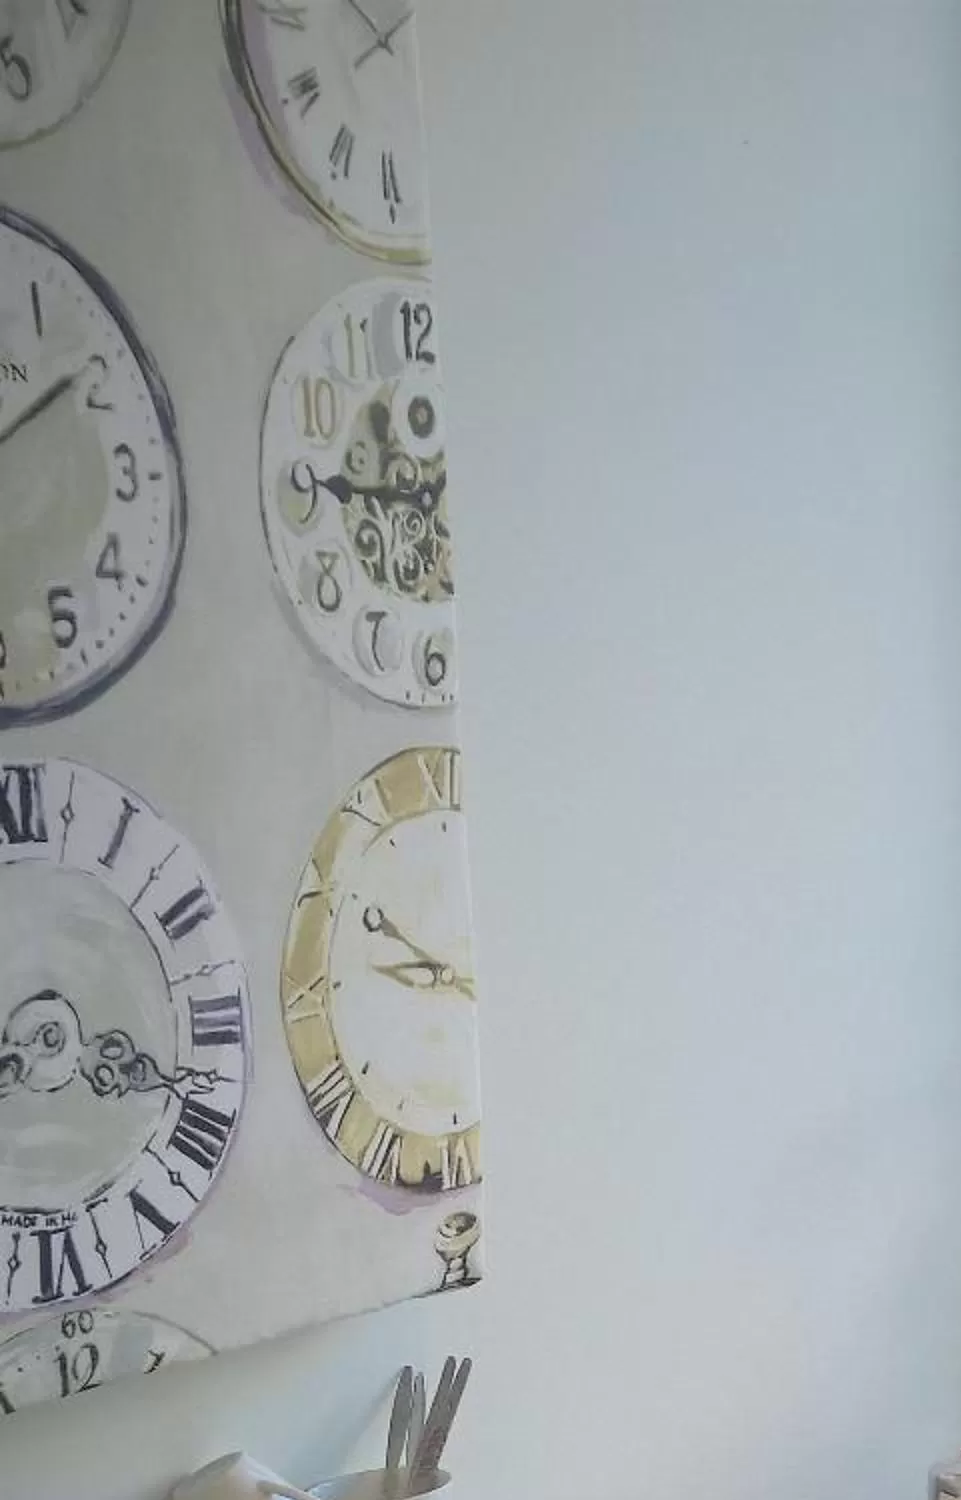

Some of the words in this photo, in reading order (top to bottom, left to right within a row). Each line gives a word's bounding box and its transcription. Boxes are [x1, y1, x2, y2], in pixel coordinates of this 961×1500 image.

[400, 300, 435, 364] 12
[302, 377, 335, 440] 10
[113, 443, 138, 503] 3
[95, 532, 124, 591] 4
[315, 550, 343, 613] 8
[48, 586, 78, 649] 5
[365, 610, 387, 673] 7
[424, 636, 447, 687] 6
[1, 1214, 38, 1229] MADE
[45, 1217, 58, 1227] IN
[61, 1309, 94, 1339] 60
[53, 1343, 104, 1398] 12
